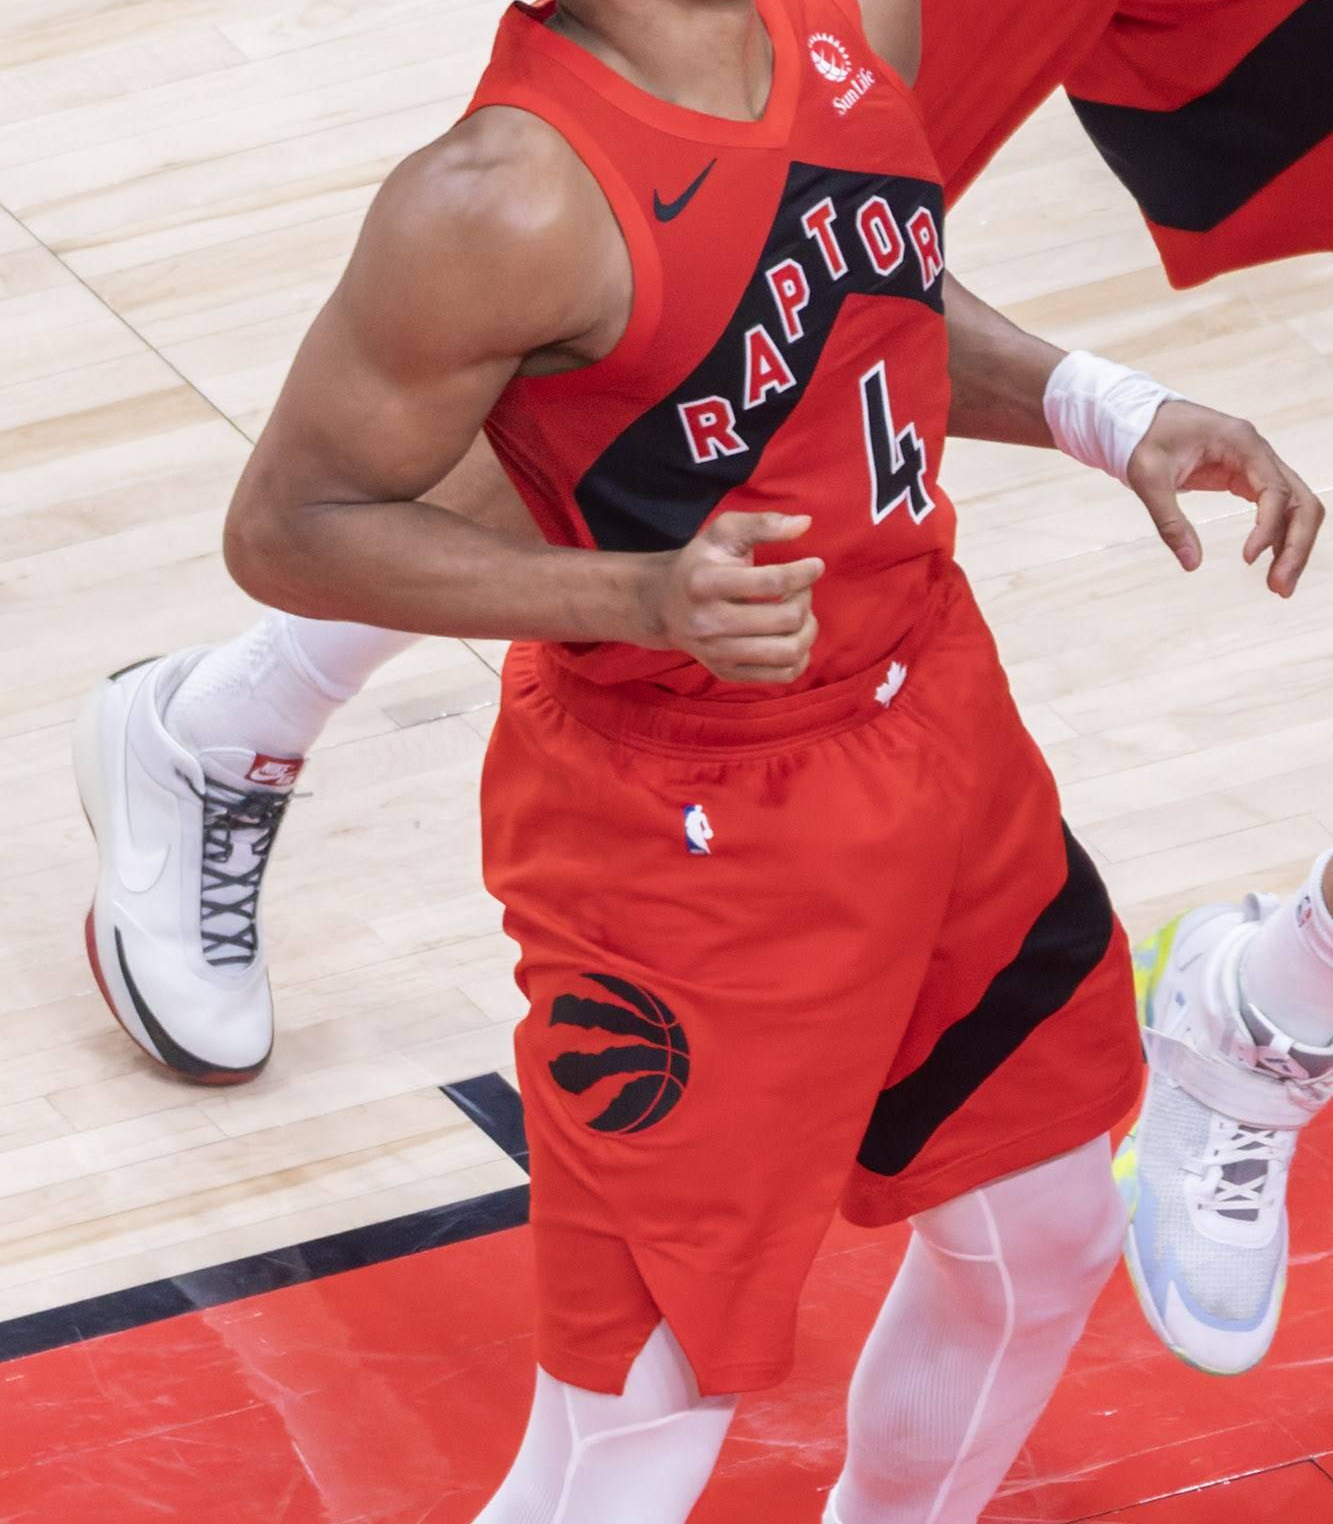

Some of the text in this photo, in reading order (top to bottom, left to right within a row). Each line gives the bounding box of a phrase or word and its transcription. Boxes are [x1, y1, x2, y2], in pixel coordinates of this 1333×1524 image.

[832, 67, 876, 115] Sun Life
[677, 195, 944, 465] RAPTOR
[859, 360, 936, 525] 4
